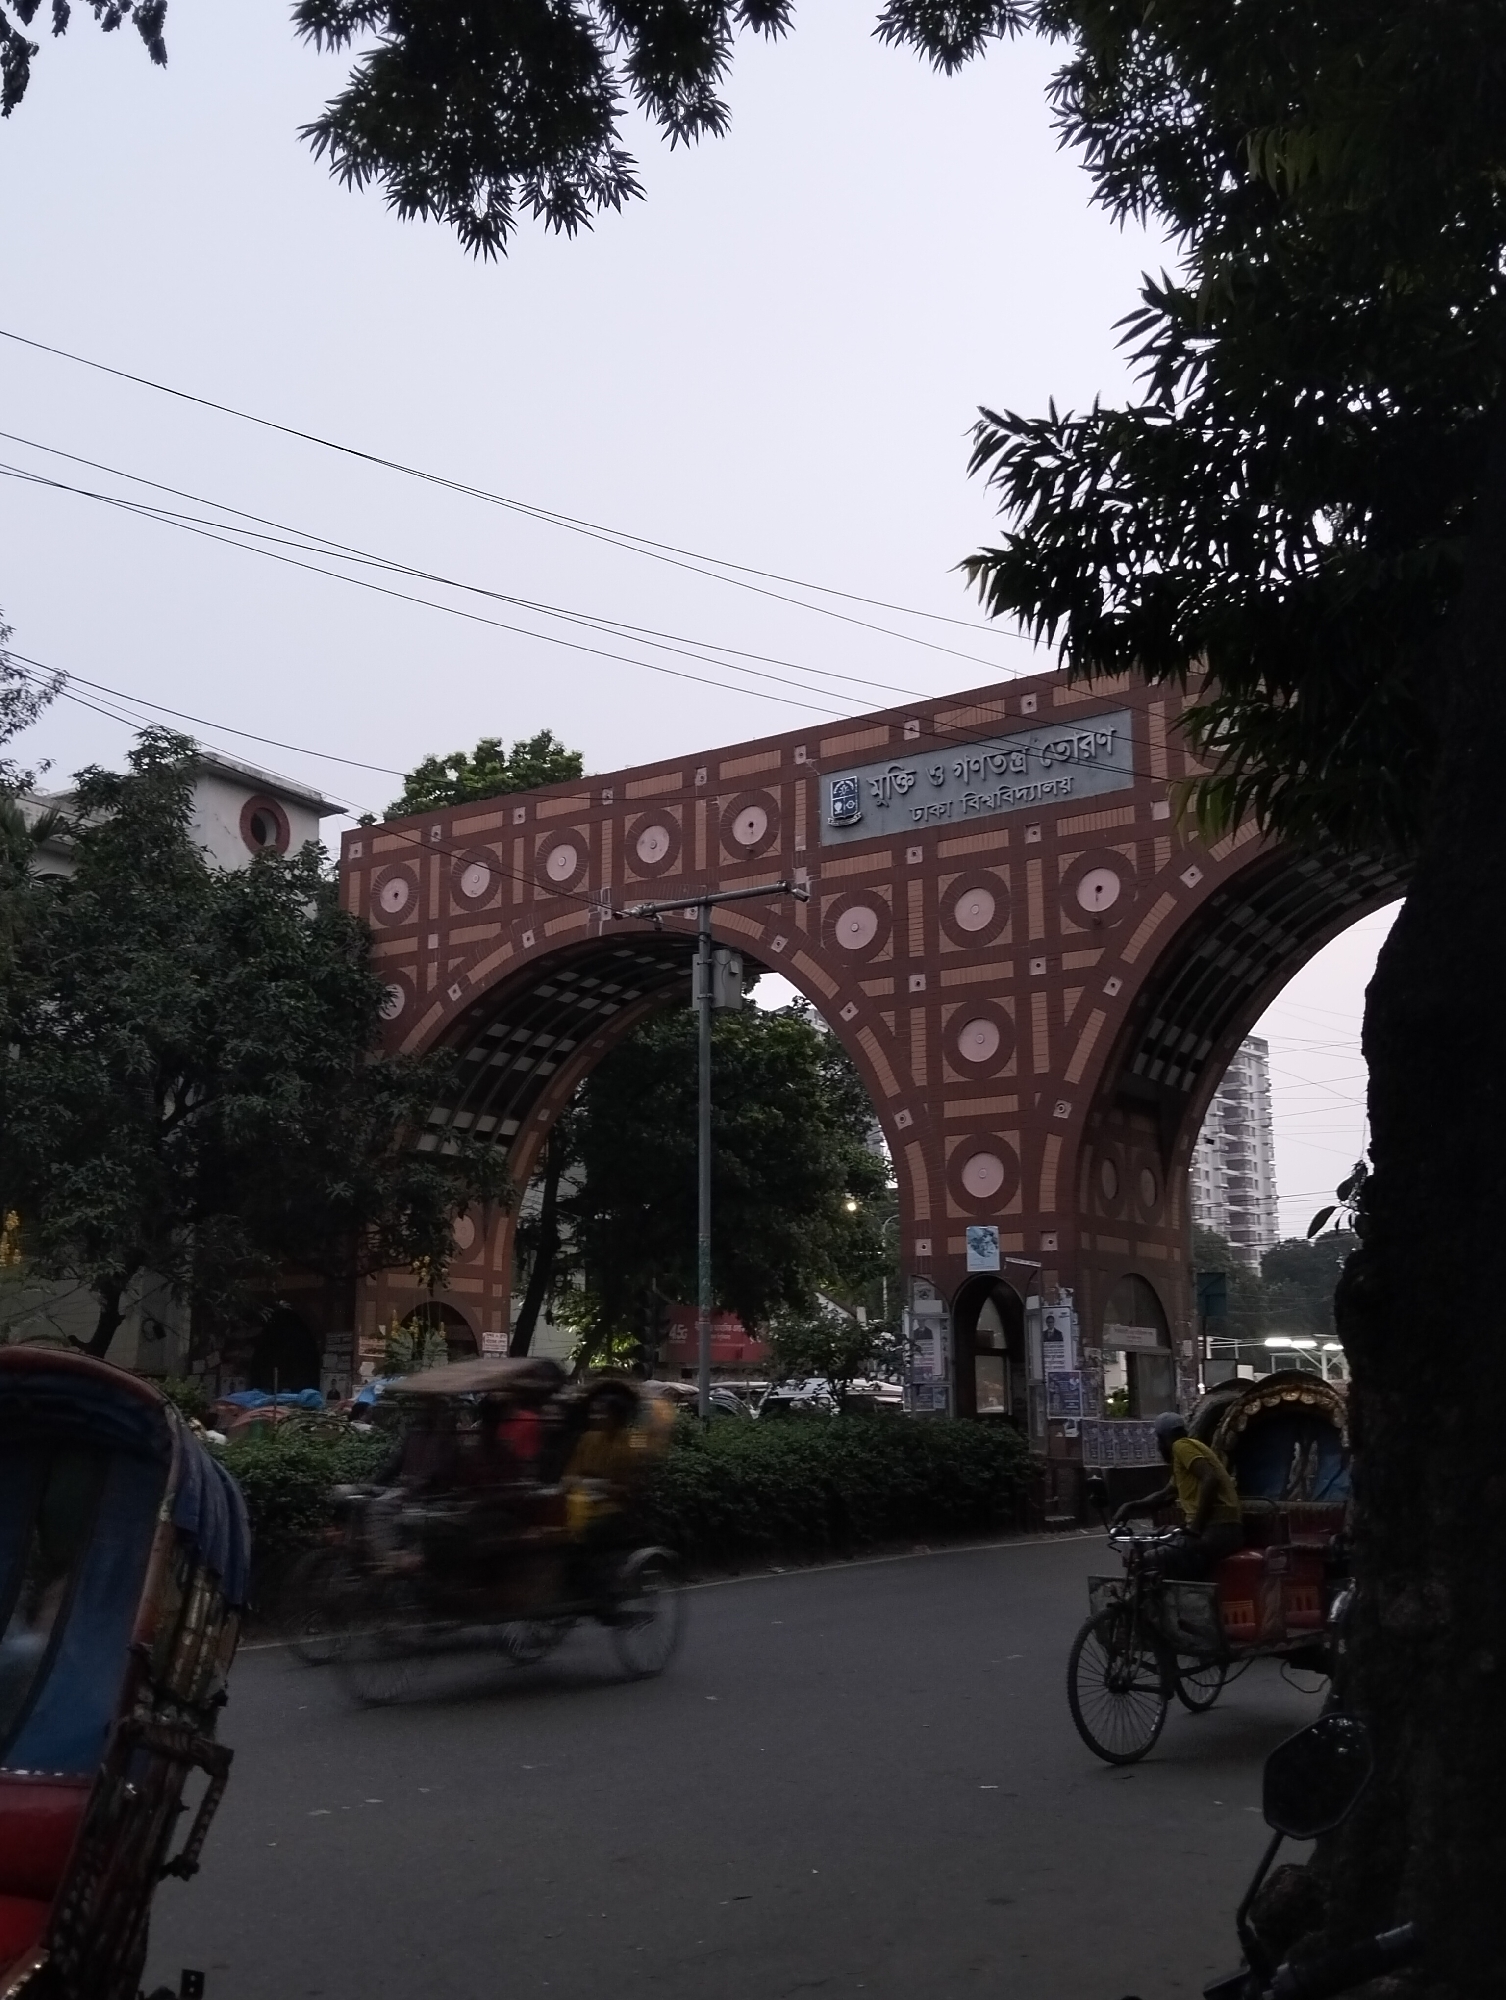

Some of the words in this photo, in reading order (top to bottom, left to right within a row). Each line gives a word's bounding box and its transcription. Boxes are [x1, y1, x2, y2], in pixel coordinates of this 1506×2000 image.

[866, 763, 917, 808] মুক্তি
[926, 764, 944, 787] ও
[953, 746, 1030, 785] গণতন্ত্র
[1041, 725, 1117, 768] তোরণ
[909, 800, 953, 822] ঢাকা
[960, 776, 1074, 814] বিশ্ববিদ্যালয়
